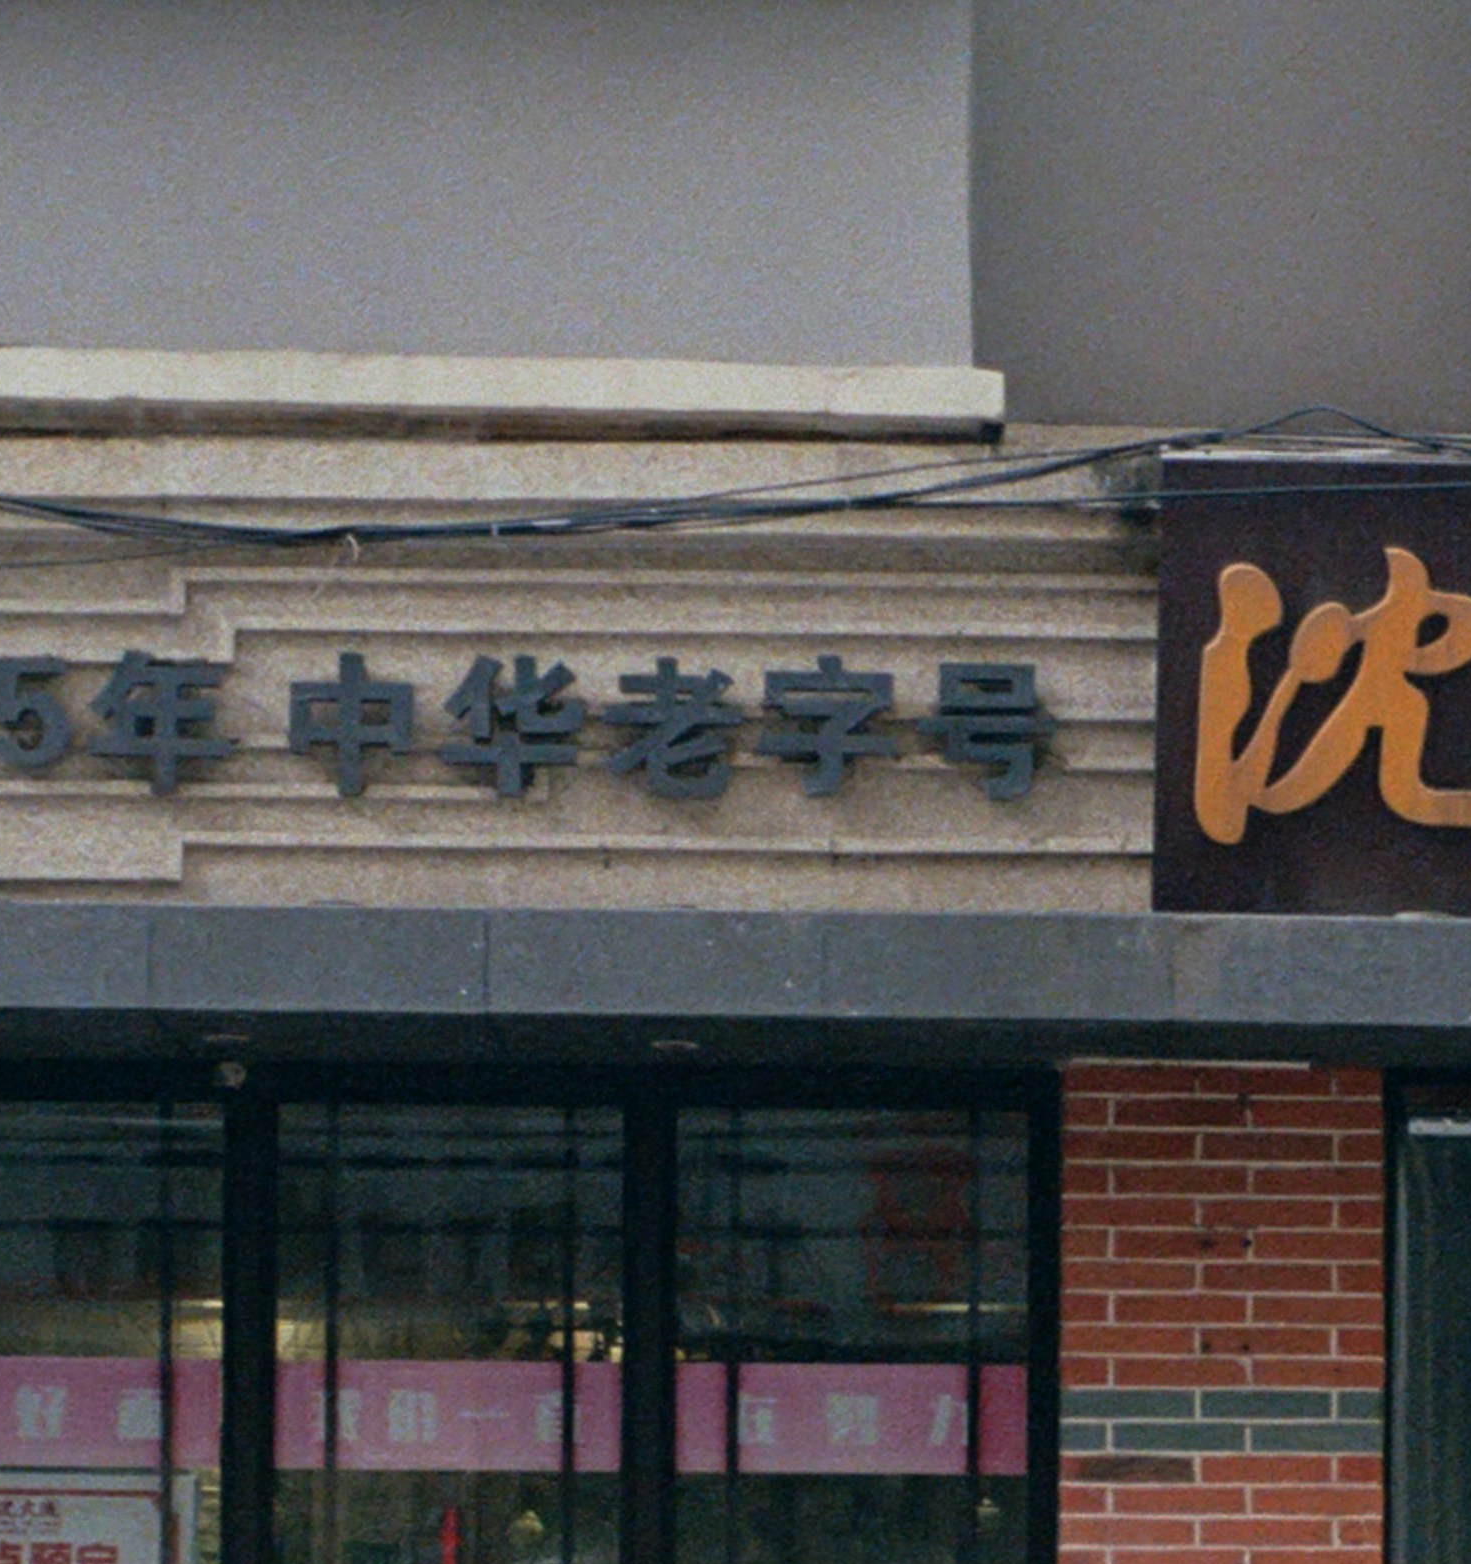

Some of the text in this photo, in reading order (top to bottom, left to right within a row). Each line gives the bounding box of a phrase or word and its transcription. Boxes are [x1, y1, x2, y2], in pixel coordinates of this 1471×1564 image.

[286, 651, 1055, 800] 中华老字号
